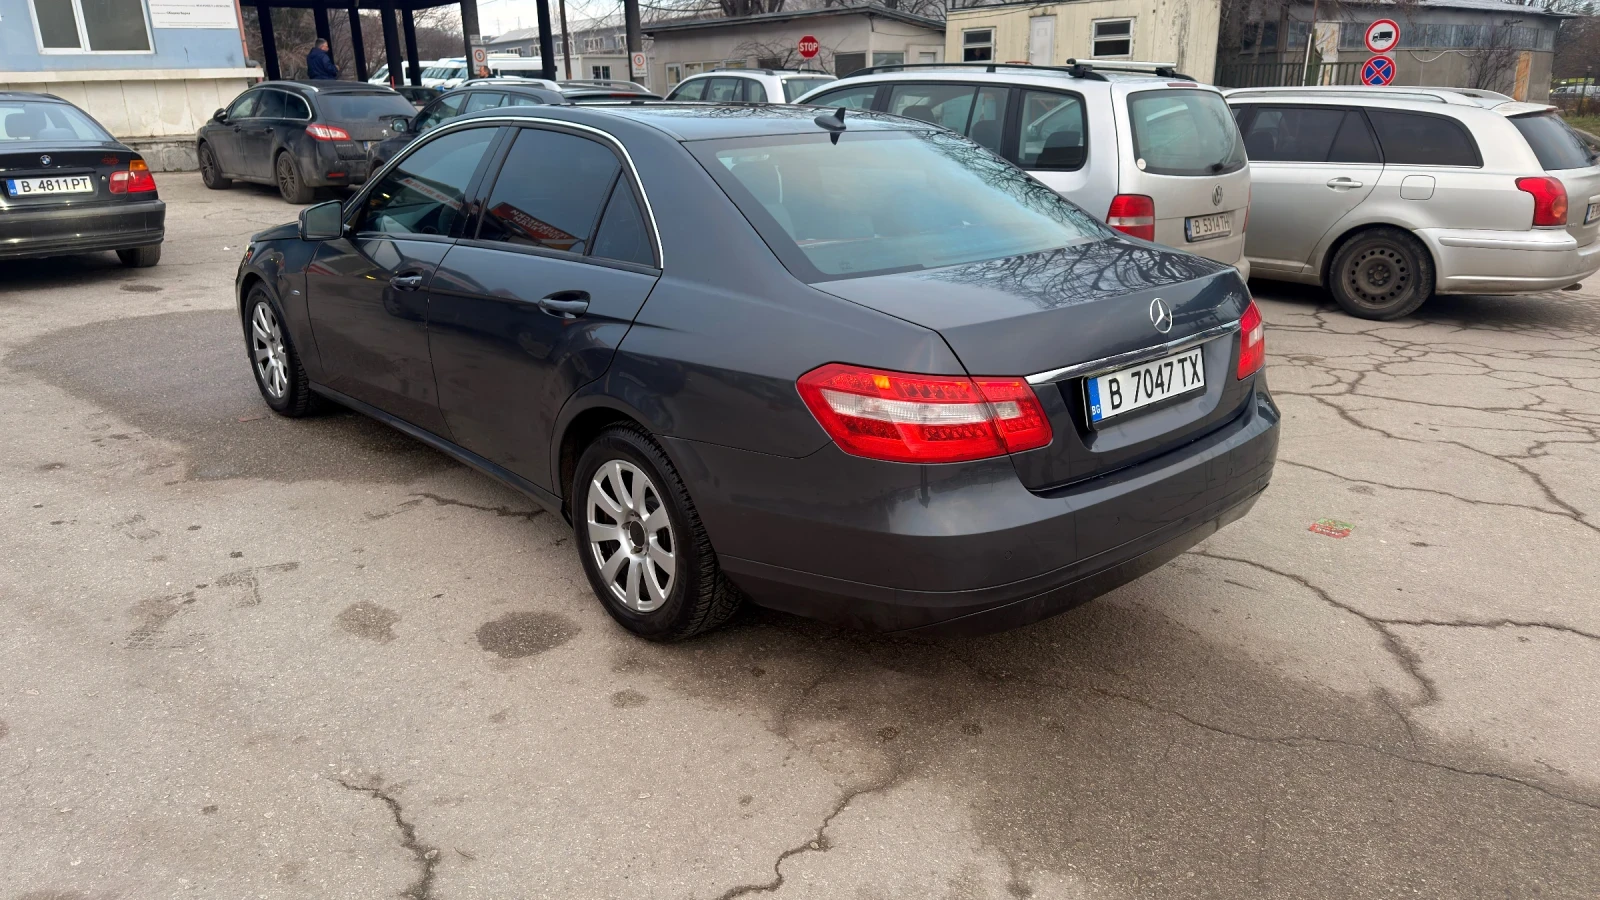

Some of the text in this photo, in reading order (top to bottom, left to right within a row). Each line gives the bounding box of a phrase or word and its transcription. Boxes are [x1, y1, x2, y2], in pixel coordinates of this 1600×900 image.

[799, 42, 818, 52] STOP
[20, 180, 32, 193] B
[1194, 219, 1201, 234] B
[1108, 353, 1201, 411] B 7047 TX
[1091, 404, 1101, 416] BG
